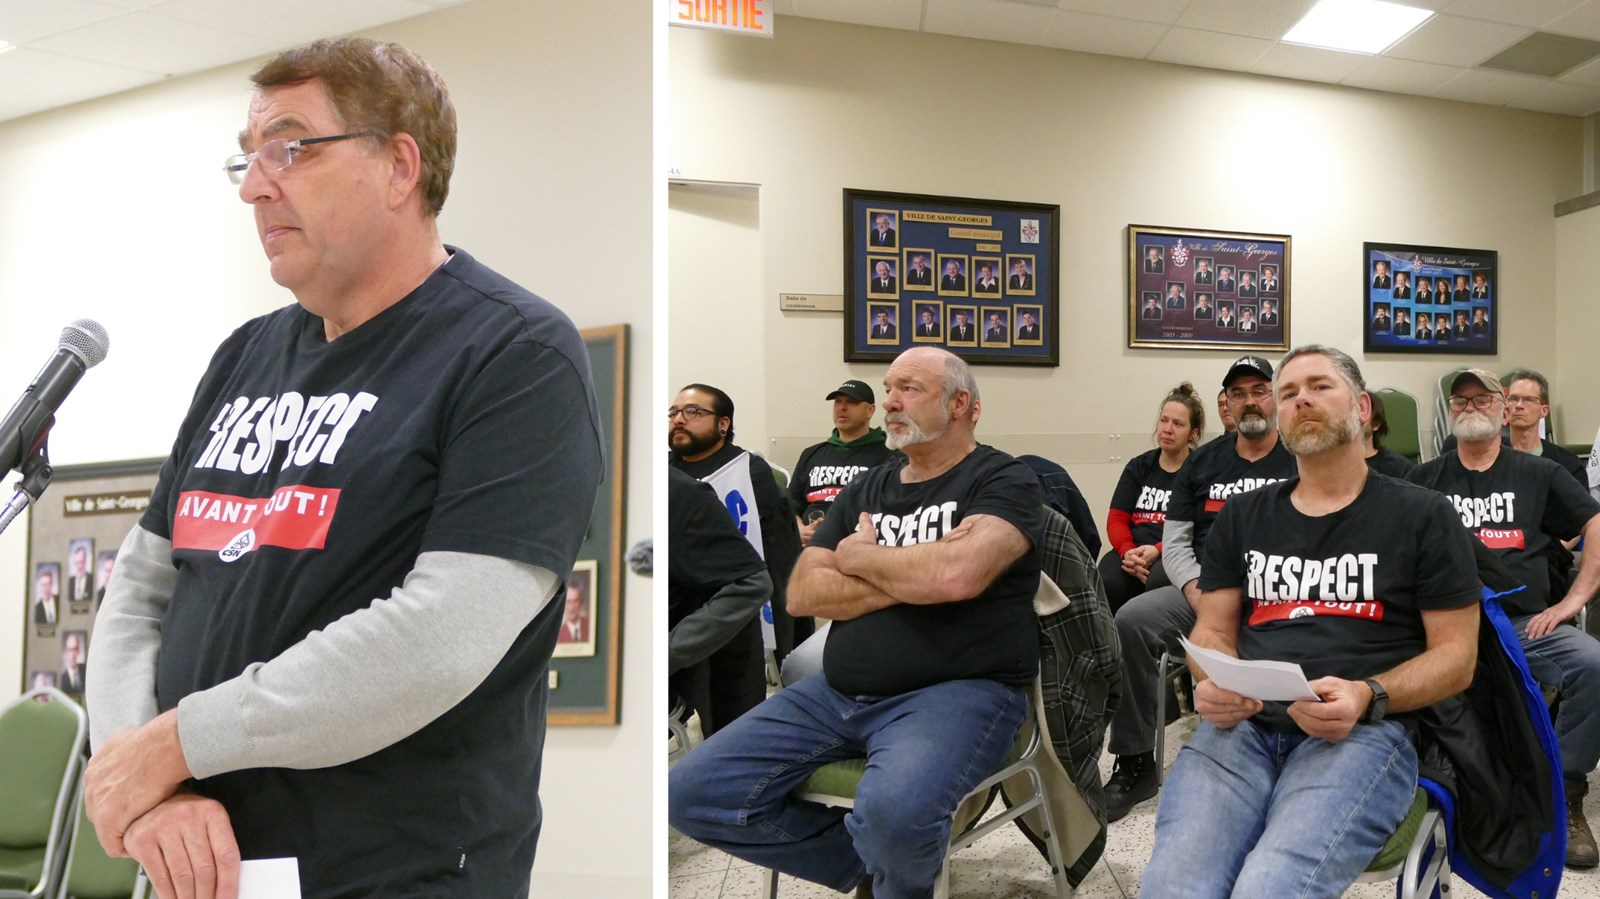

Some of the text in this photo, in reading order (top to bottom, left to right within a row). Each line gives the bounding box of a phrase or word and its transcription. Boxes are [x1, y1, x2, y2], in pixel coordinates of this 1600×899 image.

[678, 0, 763, 30] SORTIE
[906, 212, 924, 220] VILLE
[936, 215, 989, 224] SAINT-GEORGES
[1211, 241, 1278, 262] Saint-Georges
[1421, 255, 1436, 264] Ville
[194, 391, 379, 475] RESPECT
[65, 499, 83, 512] Ville
[84, 498, 95, 511] de
[179, 490, 328, 524] AVANT OUT!
[1446, 492, 1515, 528] ESPECT
[871, 501, 958, 548] ESPECT
[222, 549, 241, 558] CSN
[1245, 550, 1378, 601] RESPECT
